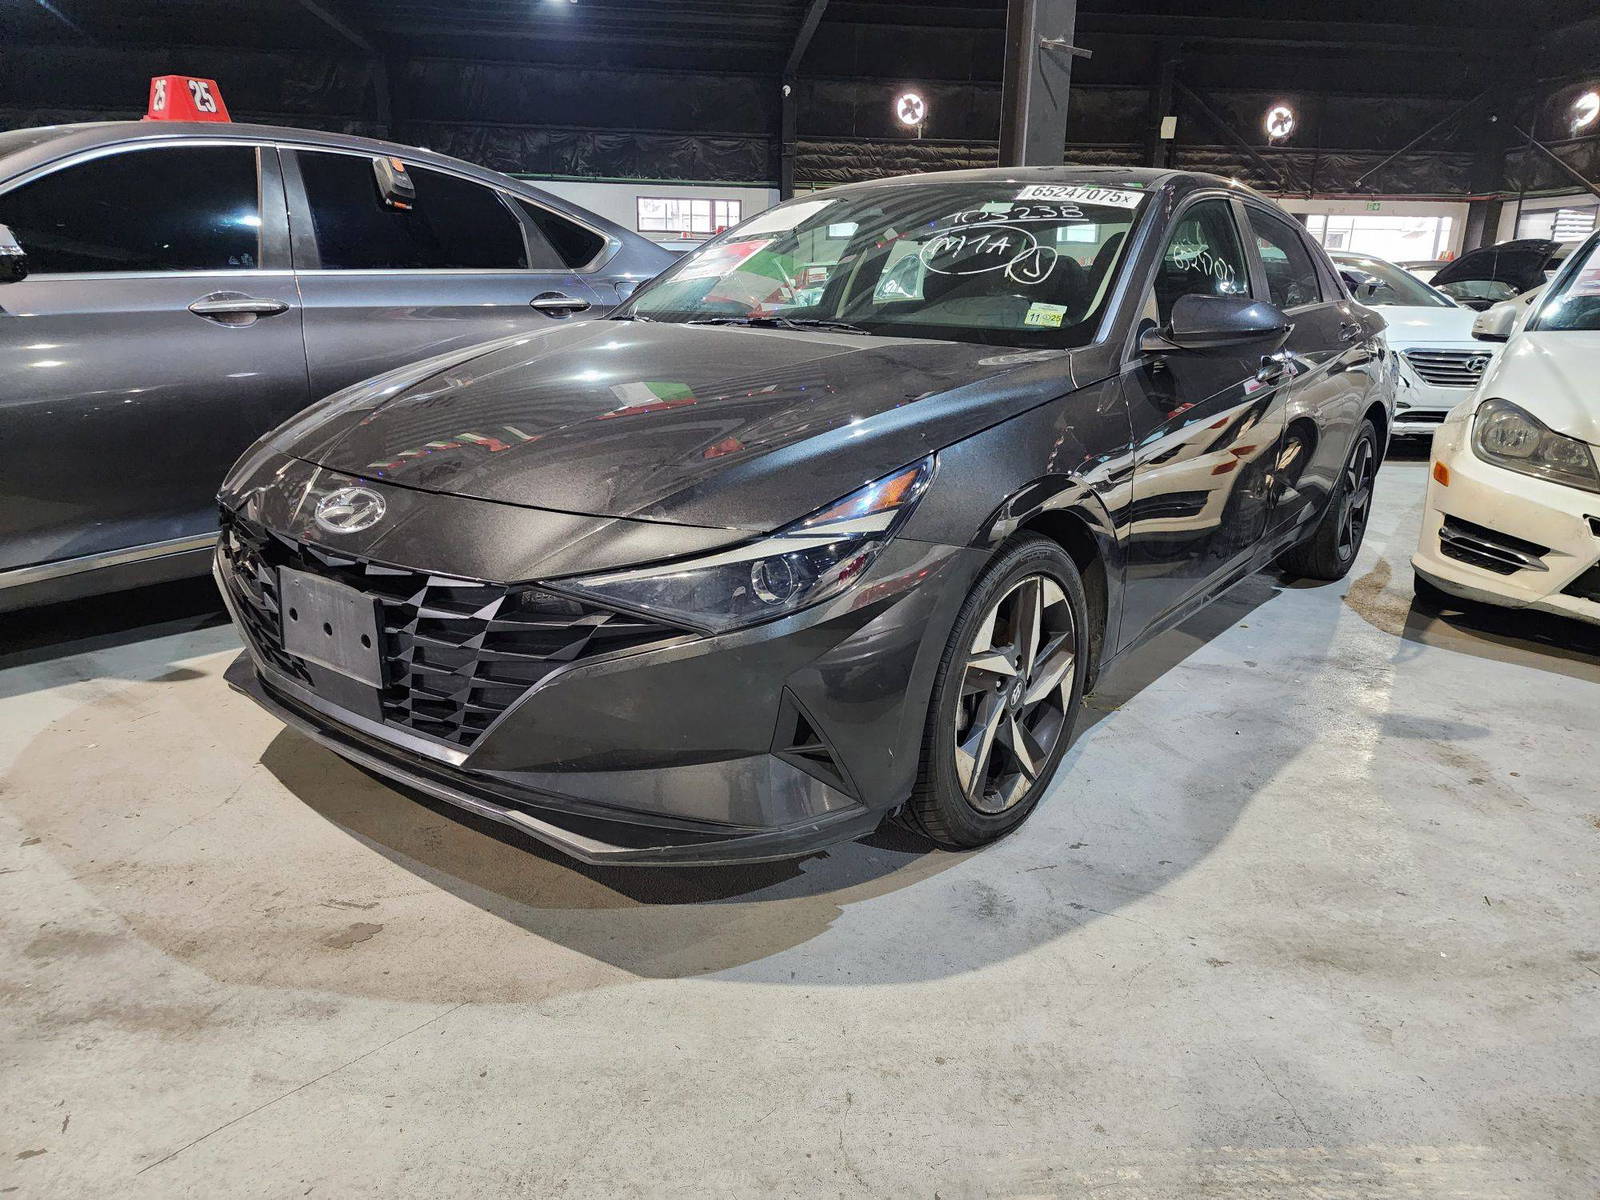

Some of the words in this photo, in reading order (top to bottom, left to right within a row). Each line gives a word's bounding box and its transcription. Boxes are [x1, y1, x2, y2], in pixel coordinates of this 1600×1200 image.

[188, 79, 217, 112] 25
[1030, 313, 1041, 322] 11
[1051, 314, 1061, 322] 25
